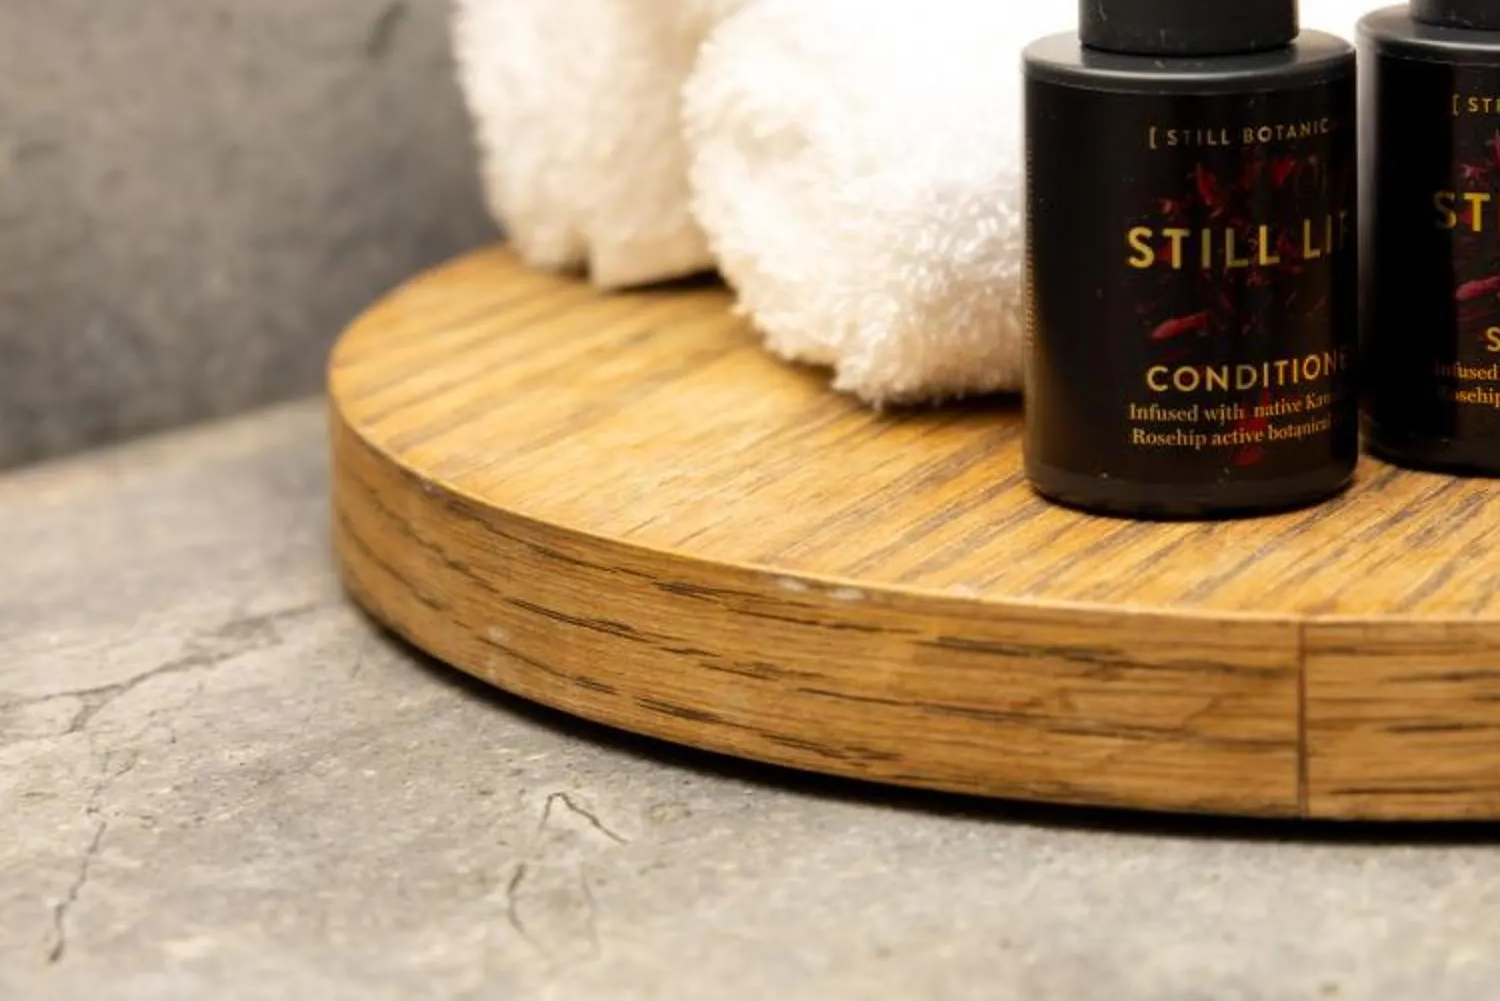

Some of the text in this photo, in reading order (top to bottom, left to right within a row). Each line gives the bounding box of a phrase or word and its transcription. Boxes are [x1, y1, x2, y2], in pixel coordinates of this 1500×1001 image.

[1127, 225, 1281, 270] STILL
[1129, 402, 1199, 422] Infused
[1131, 427, 1207, 451] Rosehip
[1211, 428, 1265, 447] active
